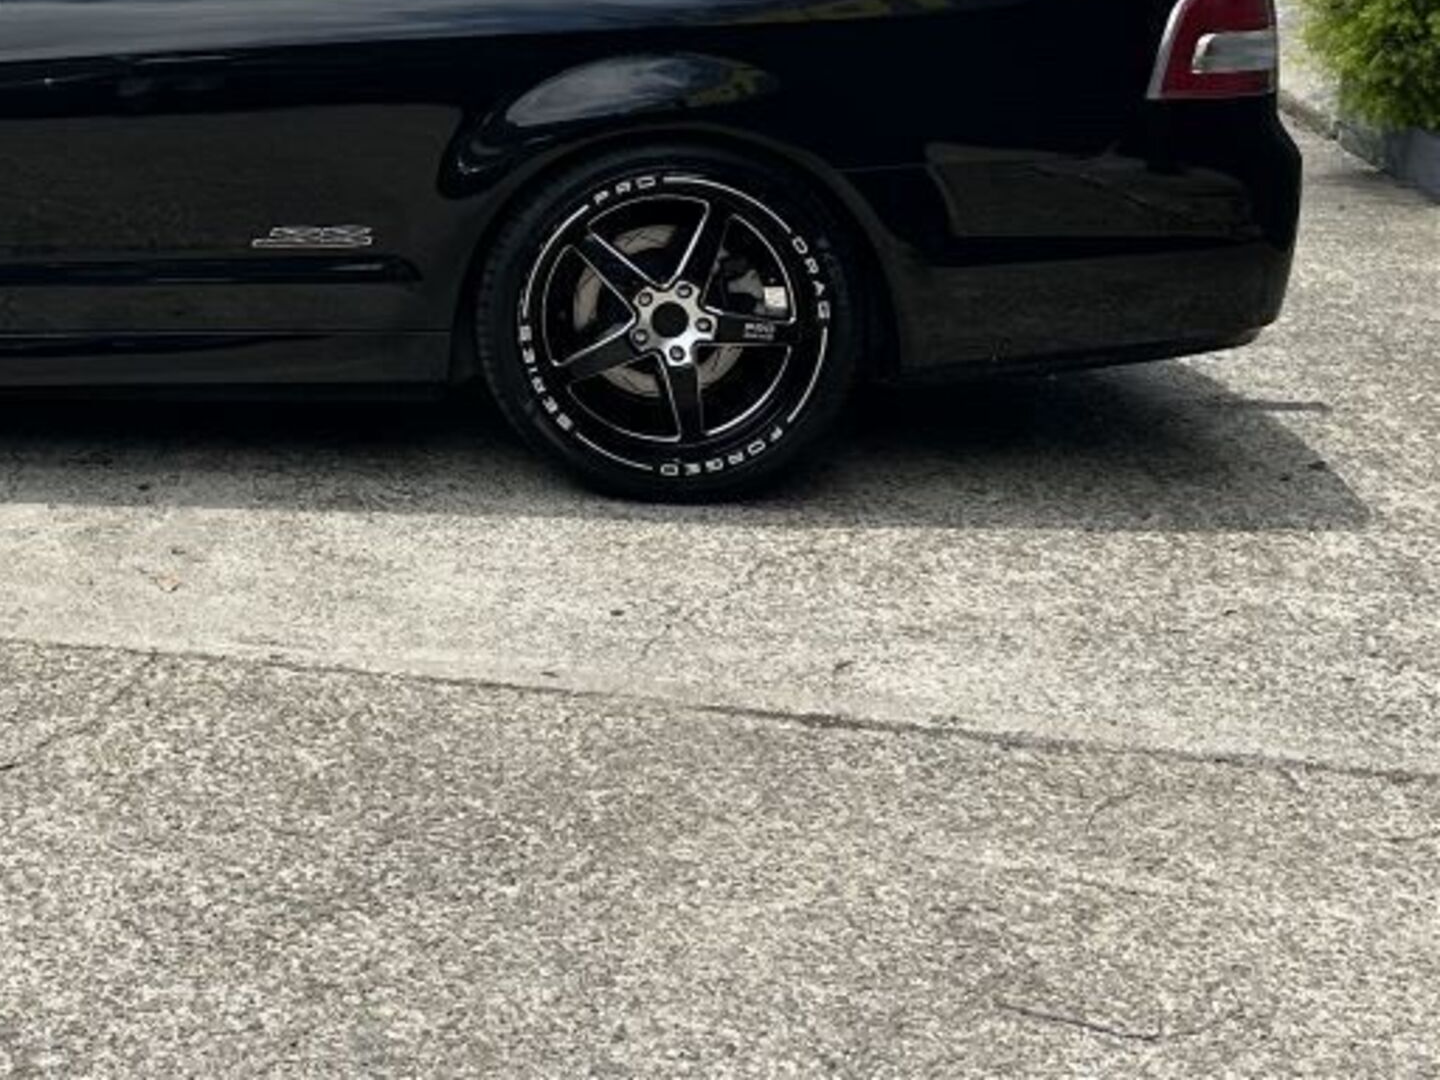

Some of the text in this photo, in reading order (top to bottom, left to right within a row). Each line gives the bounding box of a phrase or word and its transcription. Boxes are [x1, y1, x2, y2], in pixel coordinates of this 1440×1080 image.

[592, 175, 657, 206] PRO
[791, 236, 831, 320] DRAG
[659, 425, 784, 477] FORGED
